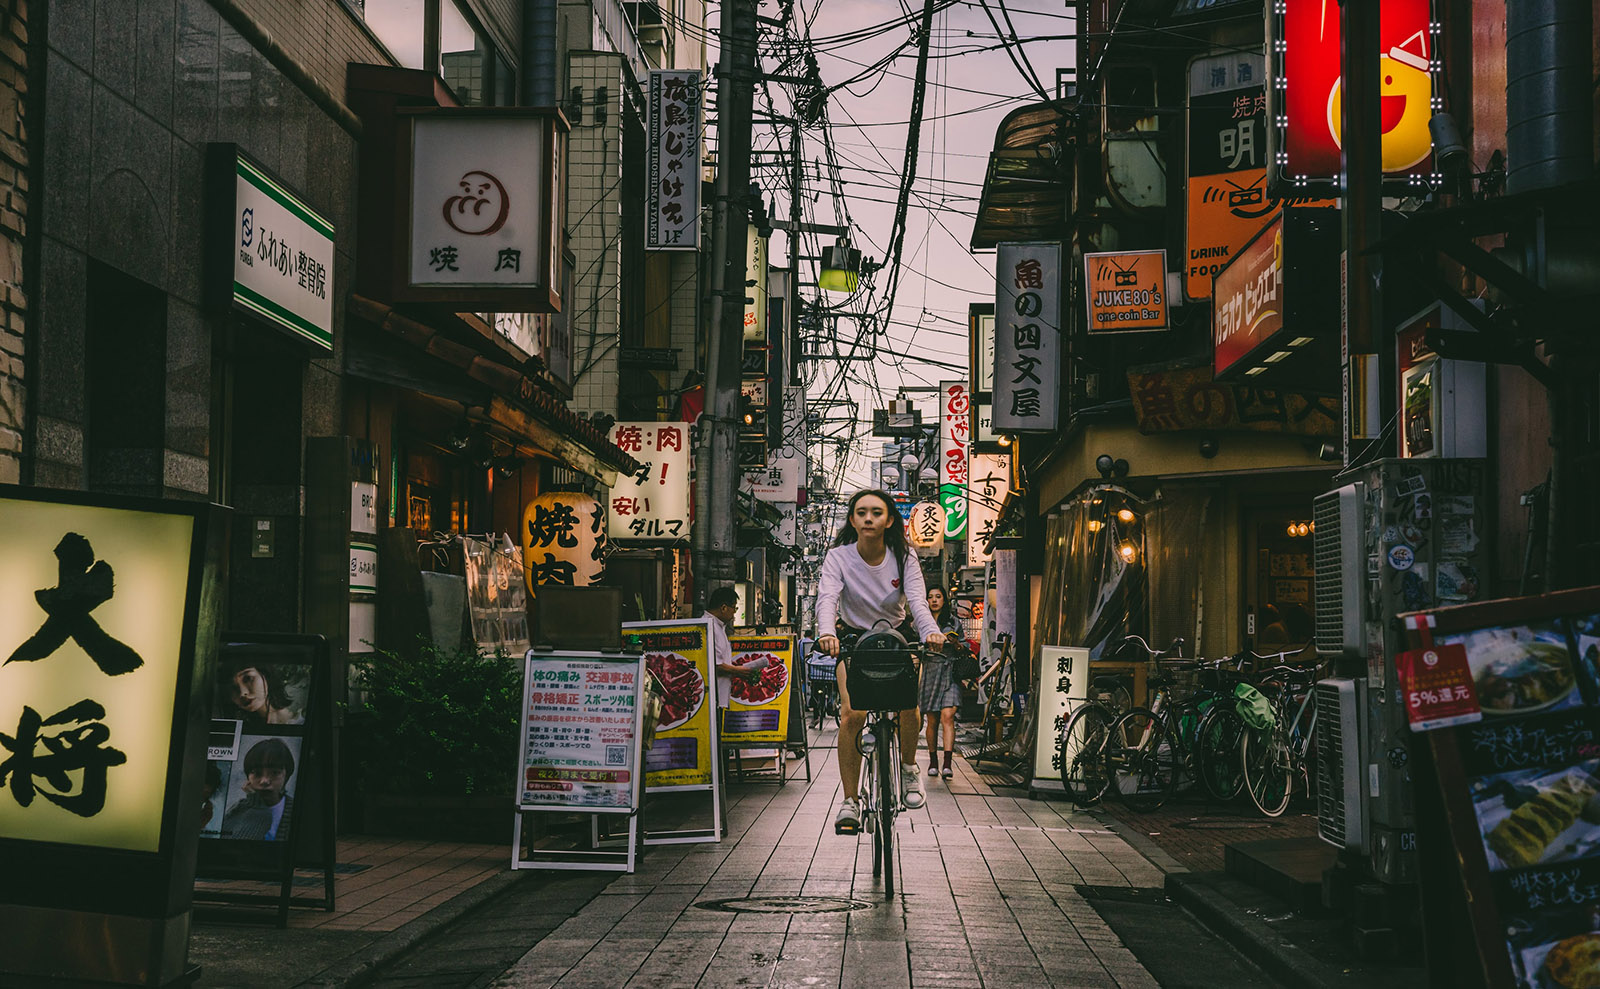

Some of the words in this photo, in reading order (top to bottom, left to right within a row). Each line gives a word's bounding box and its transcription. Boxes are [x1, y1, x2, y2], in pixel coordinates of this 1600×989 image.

[1232, 92, 1266, 118] 焼肉
[257, 227, 326, 300] ふれあい整骨院
[429, 246, 521, 273] 焼肉
[1191, 246, 1229, 259] DRINK
[1097, 312, 1116, 323] one
[1118, 310, 1140, 321] coin
[1142, 308, 1160, 320] Bar
[1010, 259, 1043, 418] 魚の四文屋
[612, 496, 650, 516] 安い
[628, 518, 683, 537] ダルマ
[528, 502, 580, 586] 焼肉
[0, 532, 144, 818] 大将
[533, 670, 581, 682] 体の痛み
[585, 671, 634, 684] 交通事故
[531, 692, 580, 705] 骨格矯正
[584, 694, 634, 707] スポーツ外傷
[1410, 685, 1470, 708] 5%還元
